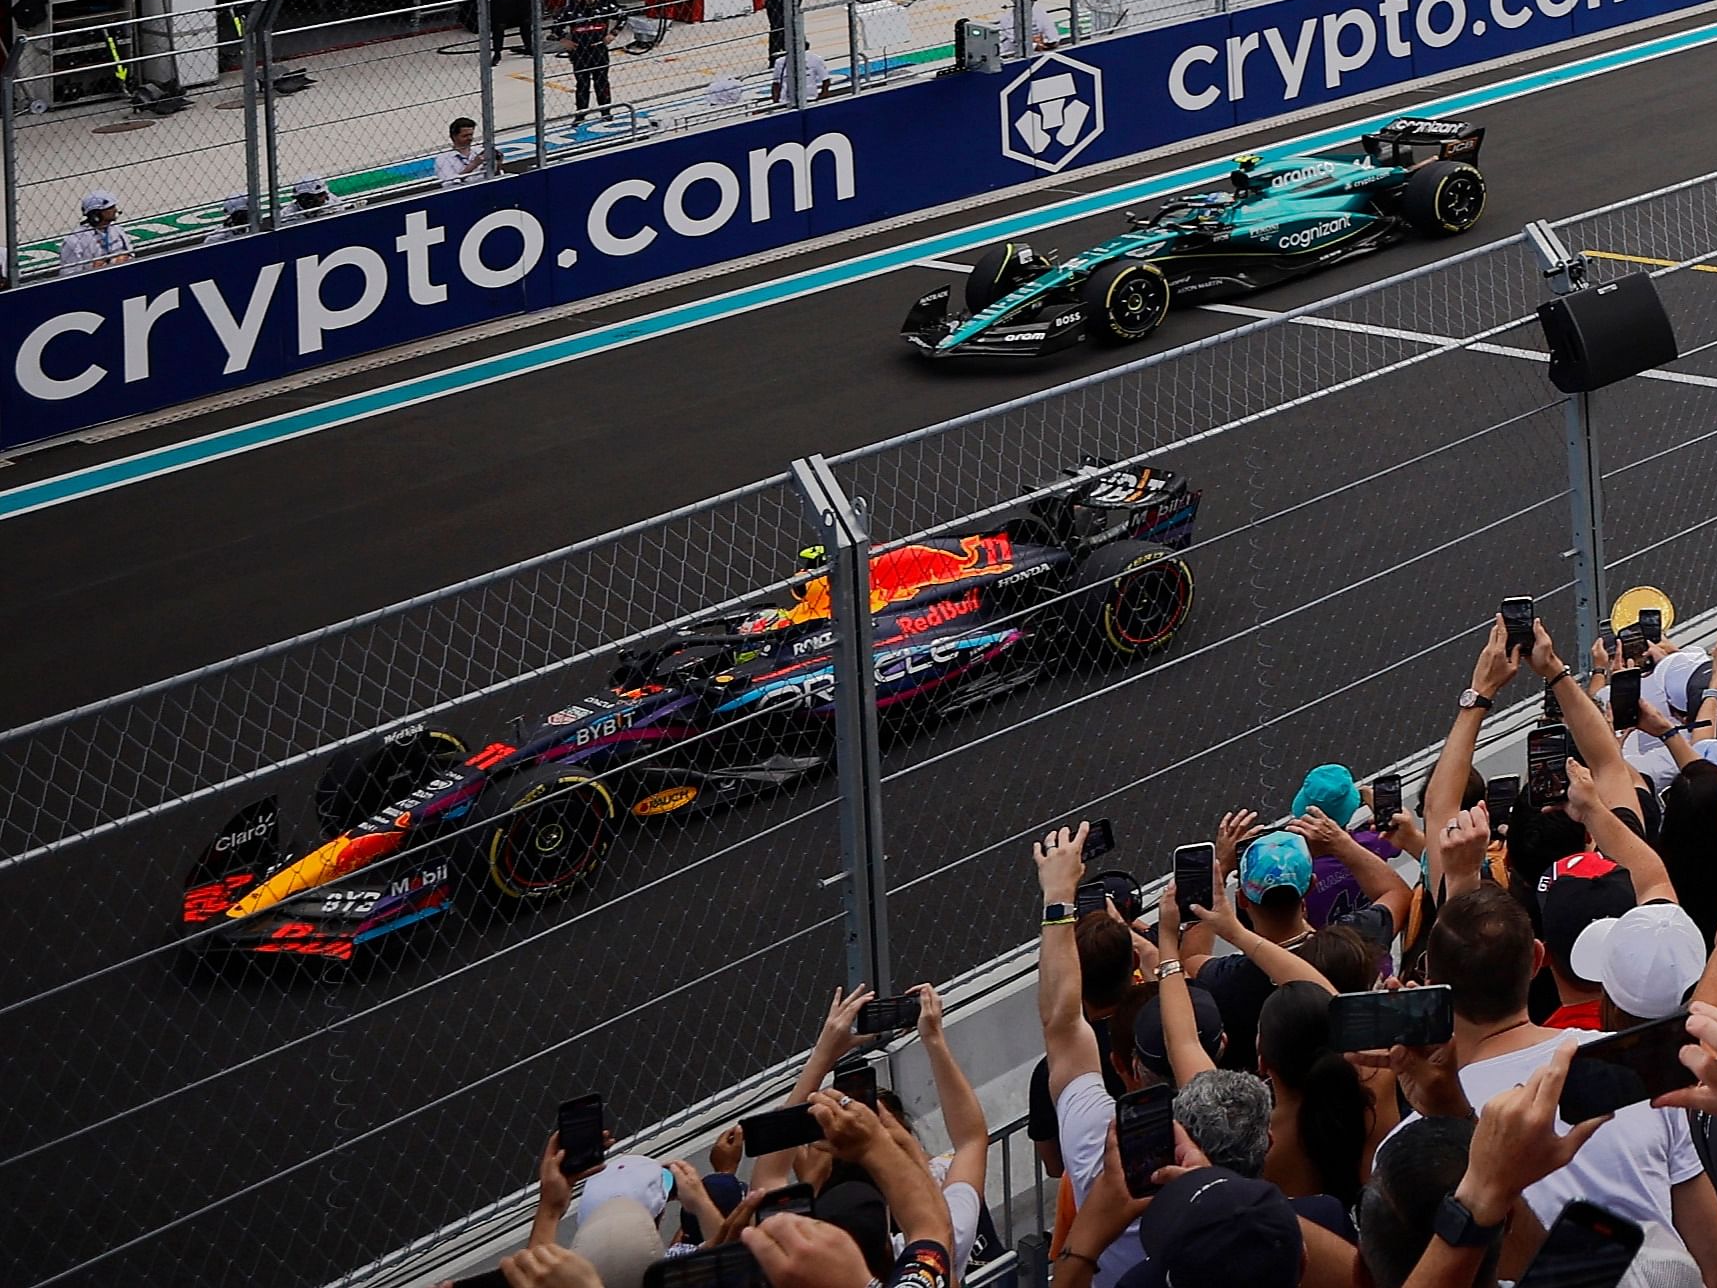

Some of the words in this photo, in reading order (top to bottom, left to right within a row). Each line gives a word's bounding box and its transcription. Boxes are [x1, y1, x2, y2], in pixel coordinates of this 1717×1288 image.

[1272, 161, 1335, 188] aramco
[1278, 214, 1352, 249] cognizant
[15, 130, 856, 400] crypto.com
[1055, 311, 1081, 327] BOSS
[997, 562, 1050, 589] HONDA
[576, 710, 636, 746] BYBIT
[215, 819, 269, 852] Claro
